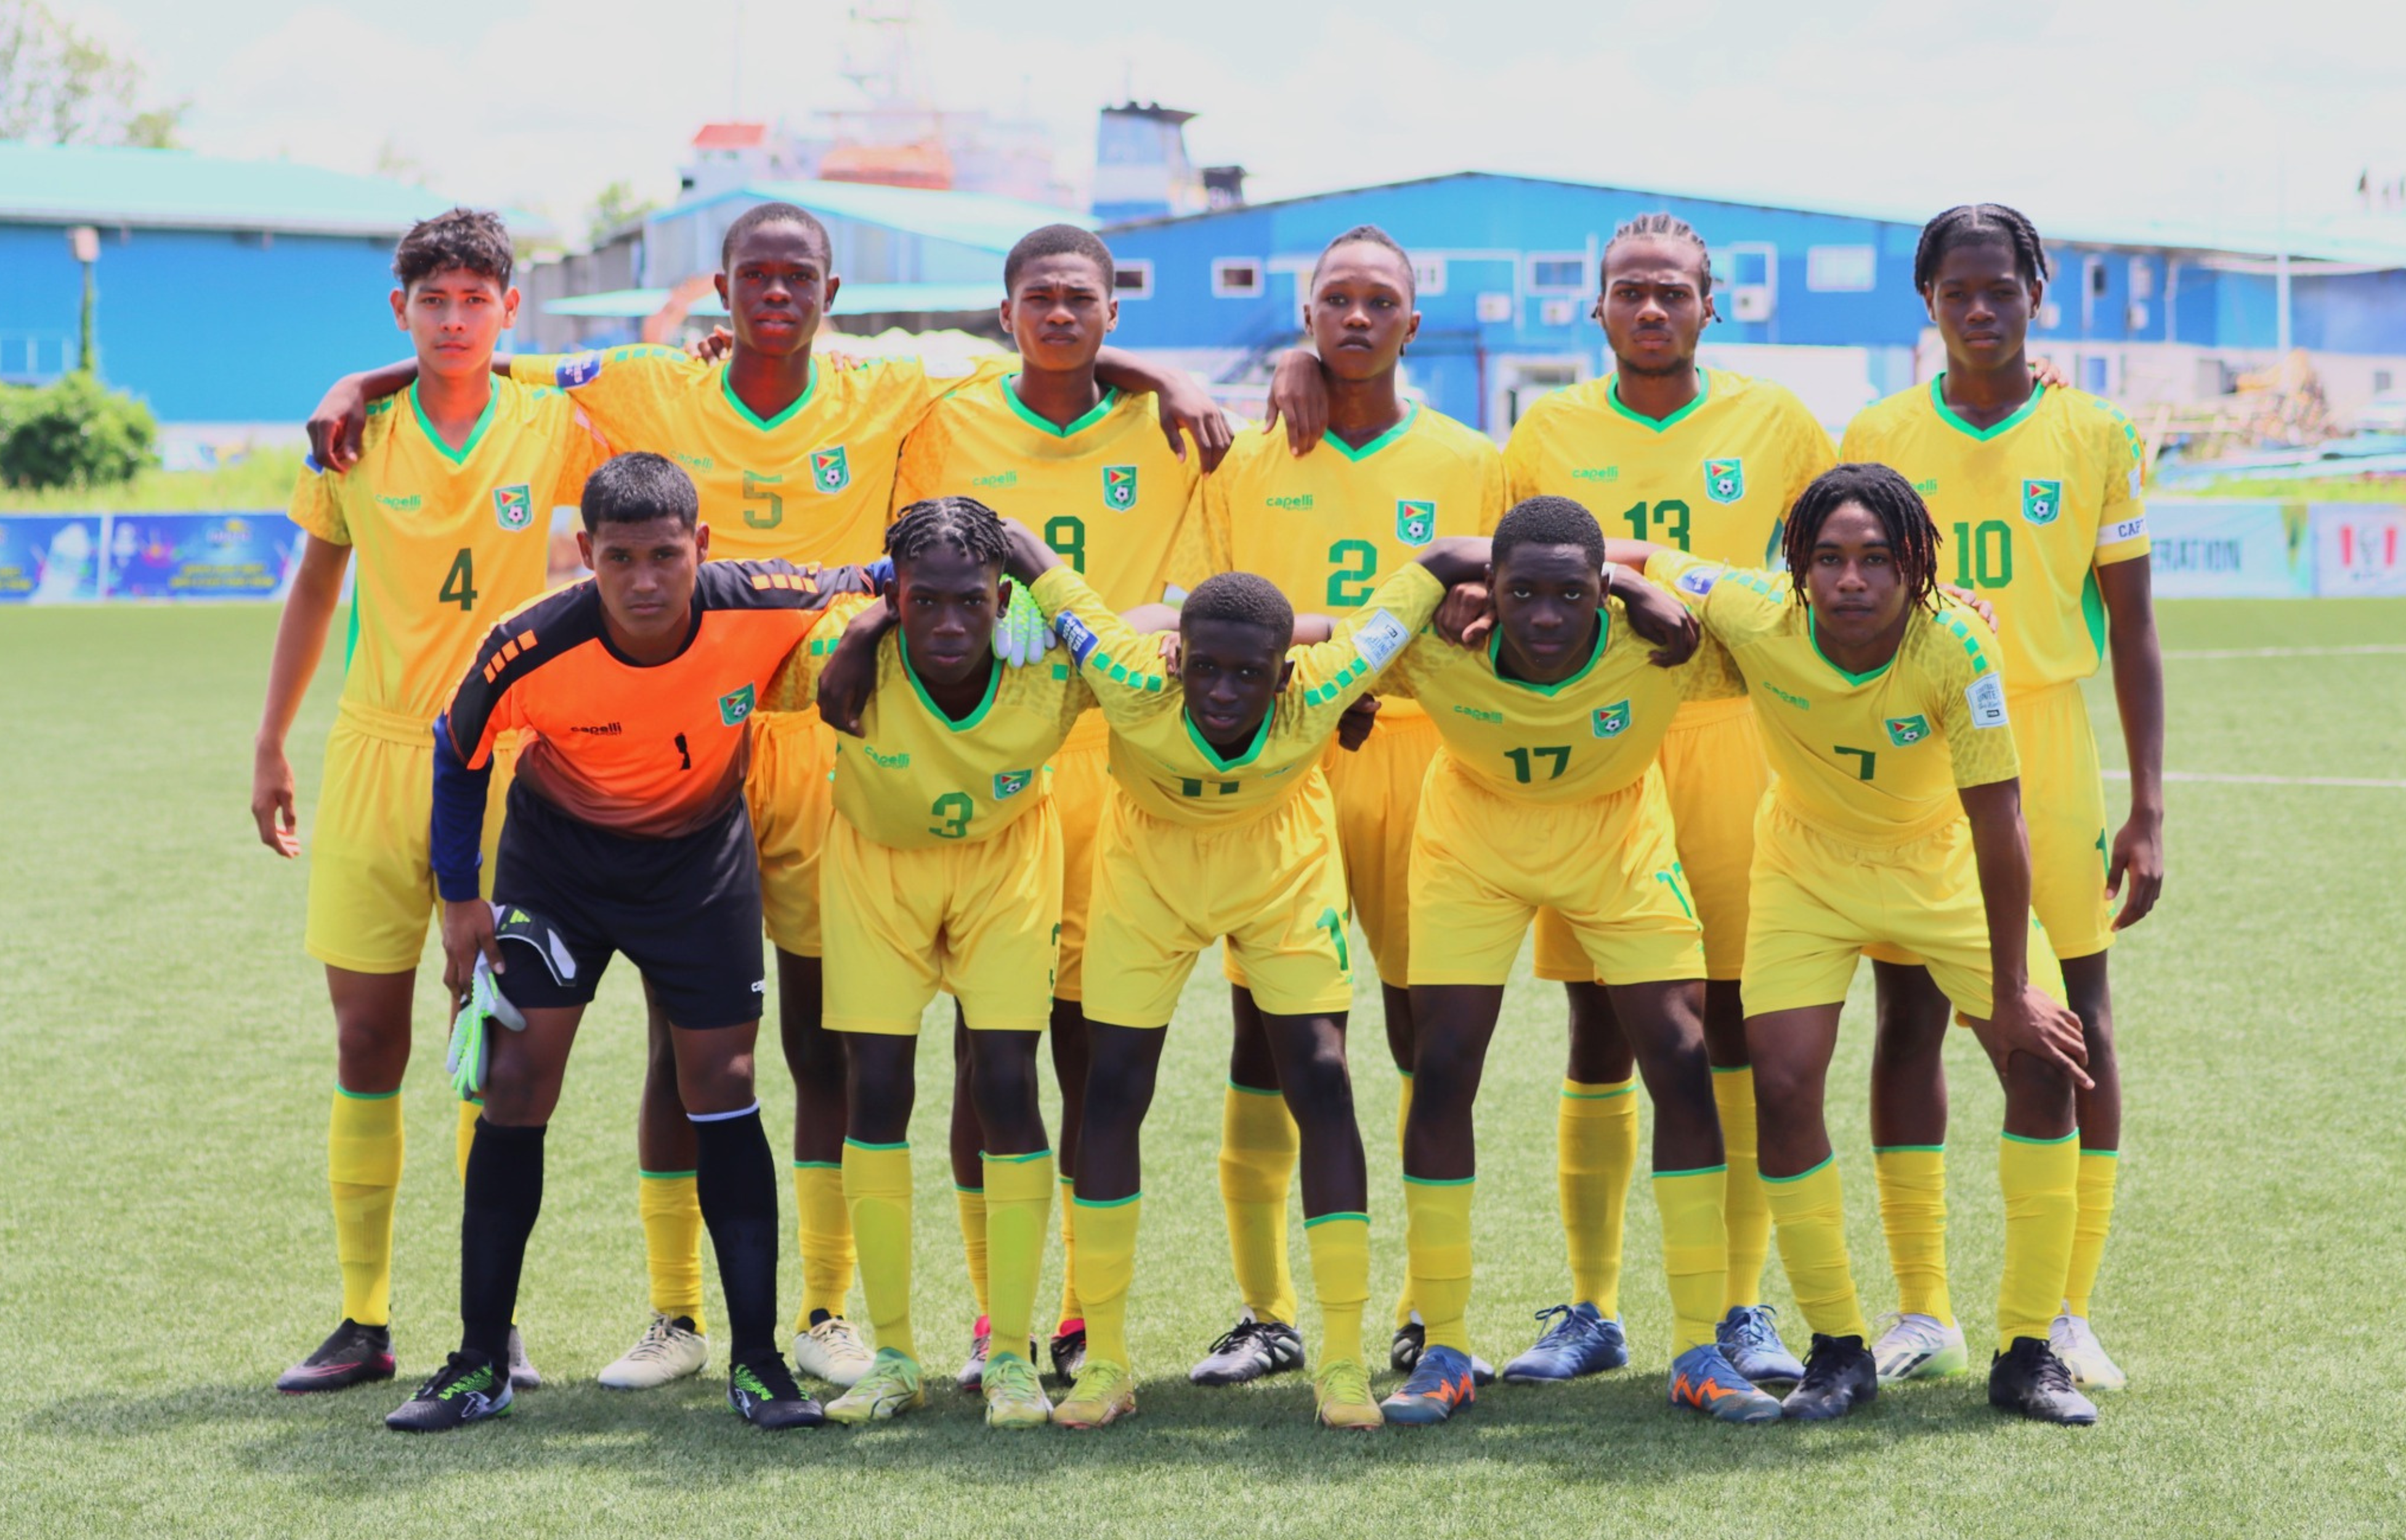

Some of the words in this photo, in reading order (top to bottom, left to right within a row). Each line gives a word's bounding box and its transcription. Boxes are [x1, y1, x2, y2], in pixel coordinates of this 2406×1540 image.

[973, 471, 1017, 487] capelli
[1573, 466, 1619, 480] capelli
[375, 494, 422, 510] capelli
[743, 470, 782, 529] 5
[1266, 495, 1314, 508] capelli
[1623, 500, 1690, 553] 13
[1326, 539, 1377, 607] 2
[1953, 520, 2012, 590] 10
[439, 548, 478, 612] 4
[570, 722, 622, 735] capelli
[674, 732, 691, 771] 1
[1504, 745, 1572, 784] 17
[1834, 745, 1876, 780] 7
[928, 792, 973, 838] 3
